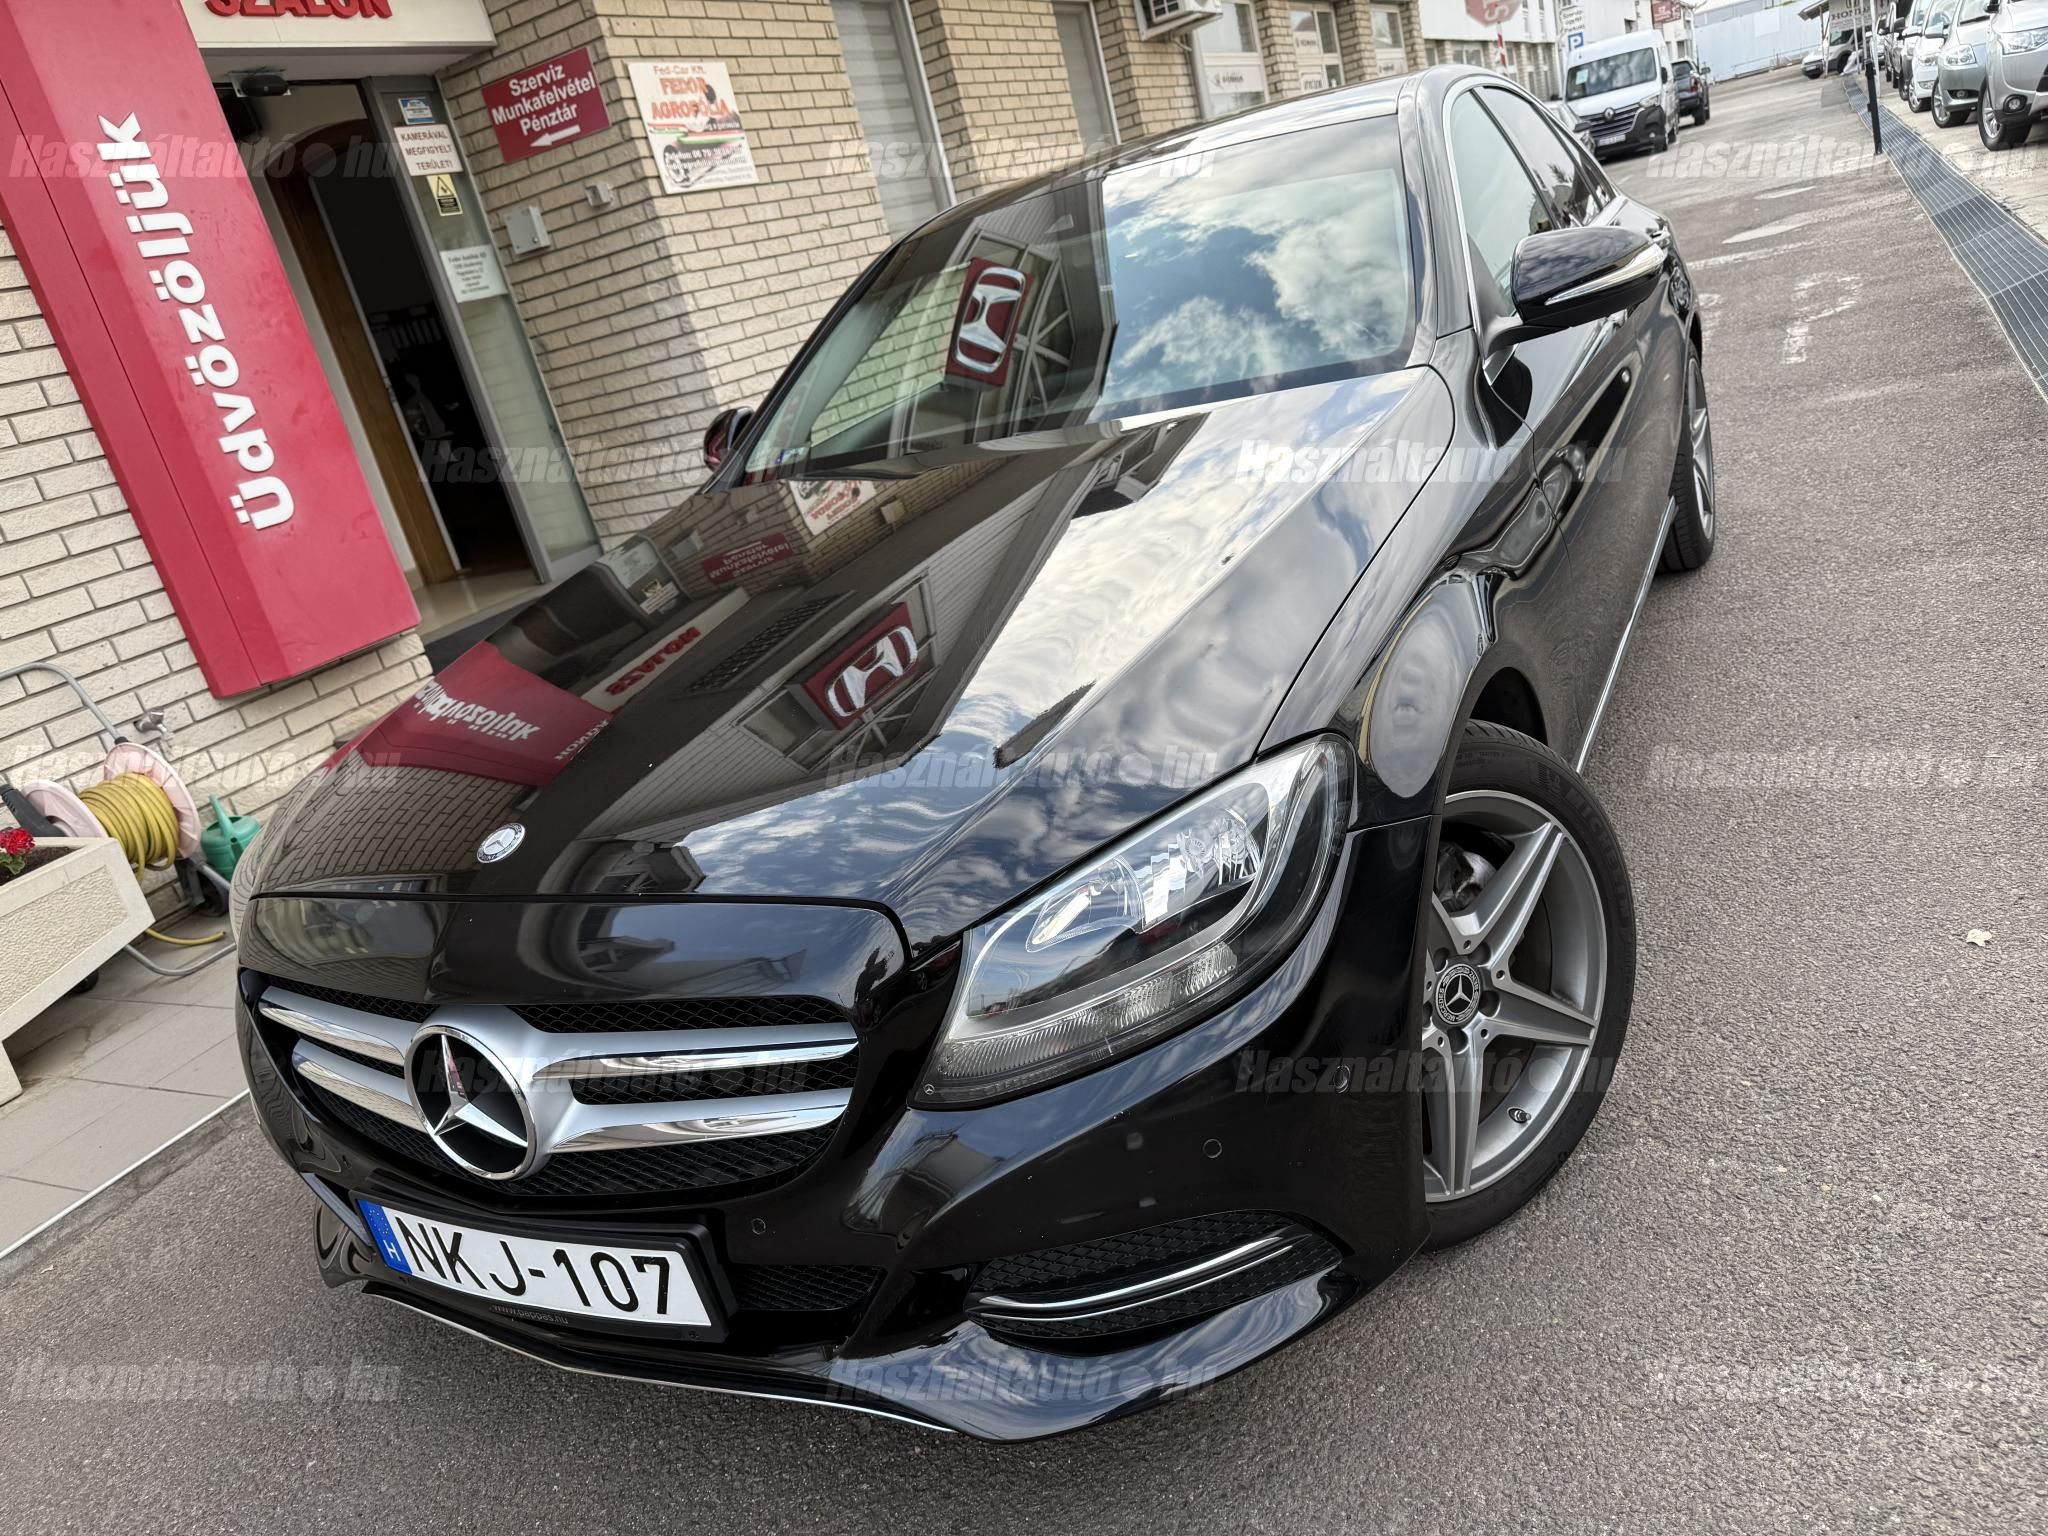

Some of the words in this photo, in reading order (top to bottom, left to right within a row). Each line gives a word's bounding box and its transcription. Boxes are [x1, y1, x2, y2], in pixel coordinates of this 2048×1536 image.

[508, 64, 565, 97] Szerviz
[491, 71, 597, 126] Munkafelvétel
[400, 130, 448, 142] KAMERÁVAL
[520, 101, 578, 137] Pénztár
[404, 145, 453, 156] MEGFIGYELT
[96, 110, 296, 531] Üdvözöljük
[385, 1238, 401, 1263] H
[394, 1215, 671, 1316] NKJ-107
